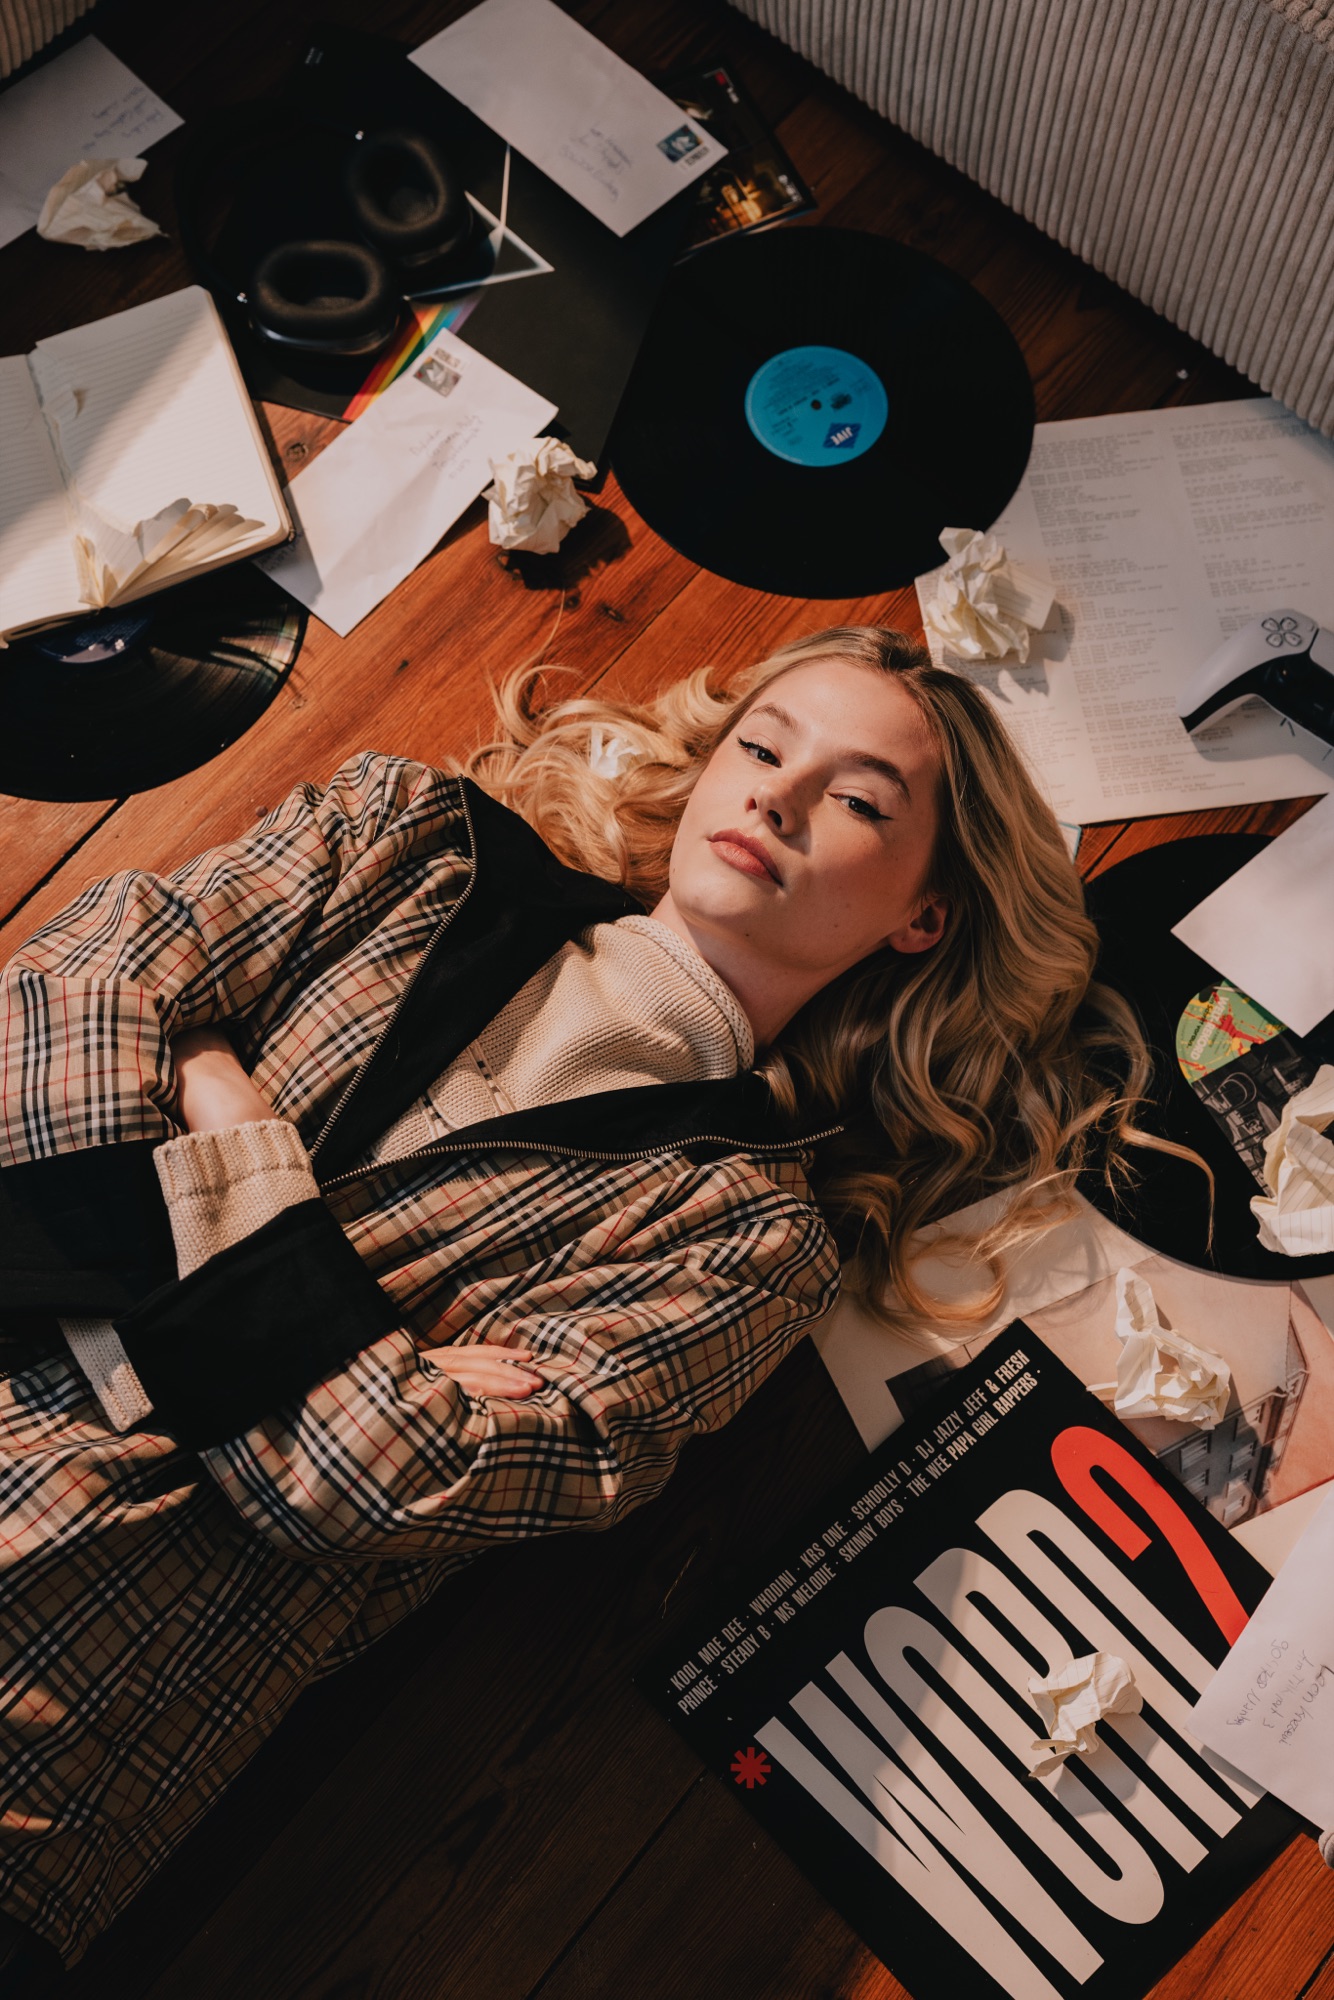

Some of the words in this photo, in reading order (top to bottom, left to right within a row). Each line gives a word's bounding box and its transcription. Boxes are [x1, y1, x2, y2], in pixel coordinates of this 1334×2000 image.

[829, 426, 853, 446] JIVE
[1189, 996, 1229, 1060] WELT-REKORD
[669, 1660, 703, 1692] KOOL
[697, 1636, 727, 1666] MOE
[721, 1617, 747, 1643] DEE
[748, 1569, 797, 1616] WHODINI
[799, 1542, 826, 1569] KRS
[821, 1520, 849, 1548] ONE
[850, 1469, 902, 1521] SCHOOLLY
[897, 1461, 912, 1476] D
[914, 1438, 935, 1460] DJ
[932, 1410, 964, 1445] JAZZY
[962, 1387, 988, 1417] JEFF
[984, 1378, 1001, 1394] &
[994, 1349, 1031, 1385] FRESH
[677, 1674, 719, 1716] PRINCE
[720, 1633, 761, 1675] STEADY
[756, 1624, 772, 1641] B
[773, 1601, 796, 1624] MS
[791, 1562, 837, 1607] MELODIE
[838, 1521, 878, 1563] SKINNY
[873, 1498, 904, 1529] BOYS
[905, 1473, 932, 1497] THE
[925, 1453, 952, 1480] WEE
[945, 1430, 978, 1461] PAPA
[971, 1410, 999, 1437] GIRL
[992, 1371, 1038, 1417] RAPPERS
[754, 1489, 1269, 2000] WORD
